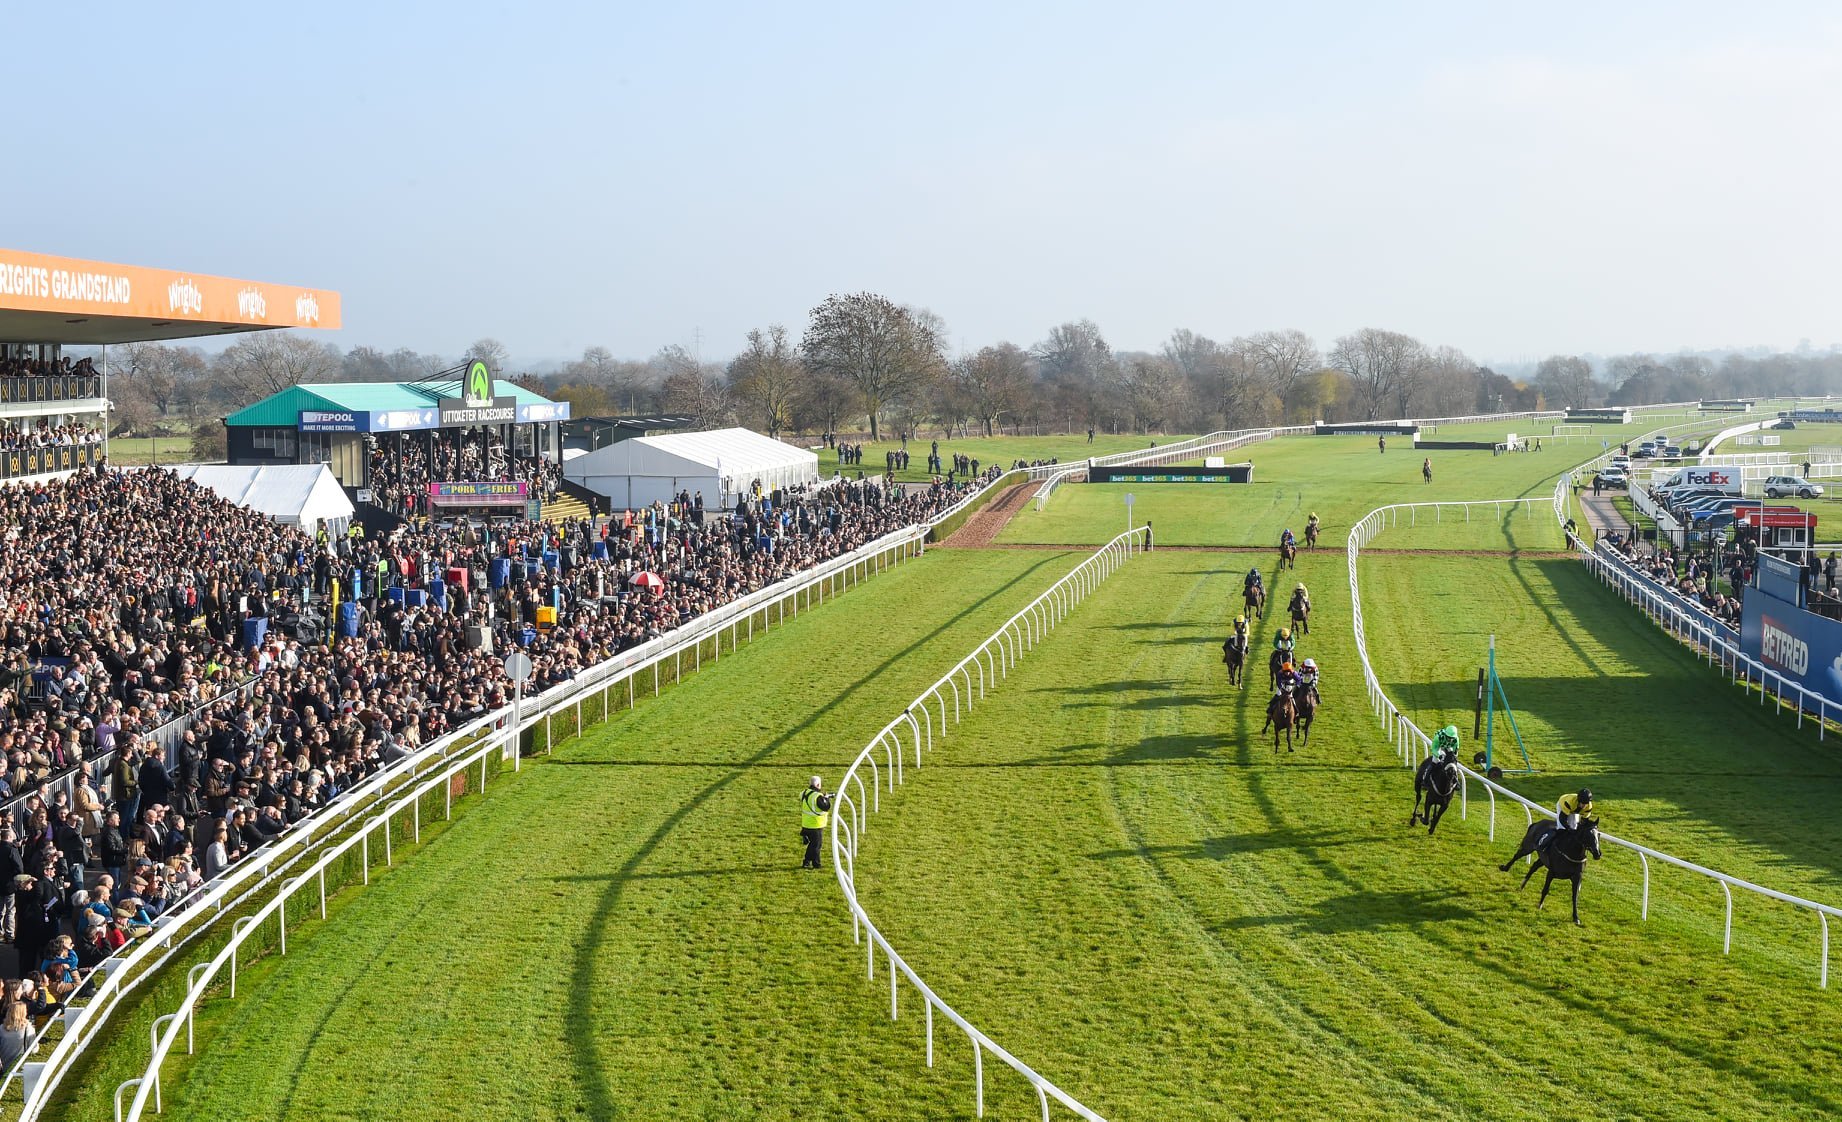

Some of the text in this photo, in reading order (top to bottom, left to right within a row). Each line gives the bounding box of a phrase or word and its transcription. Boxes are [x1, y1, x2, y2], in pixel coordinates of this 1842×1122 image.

[0, 263, 130, 304] RIGHTS GRANDSTAND
[168, 277, 202, 315] Wrights
[237, 286, 266, 319] Wrights
[295, 292, 319, 322] Wrights
[442, 407, 514, 423] UTTOXETER RACECOURSE
[451, 485, 476, 494] PORK
[491, 484, 518, 493] FRIES
[1688, 471, 1729, 484] FedEx
[1762, 623, 1809, 676] BETFRED
